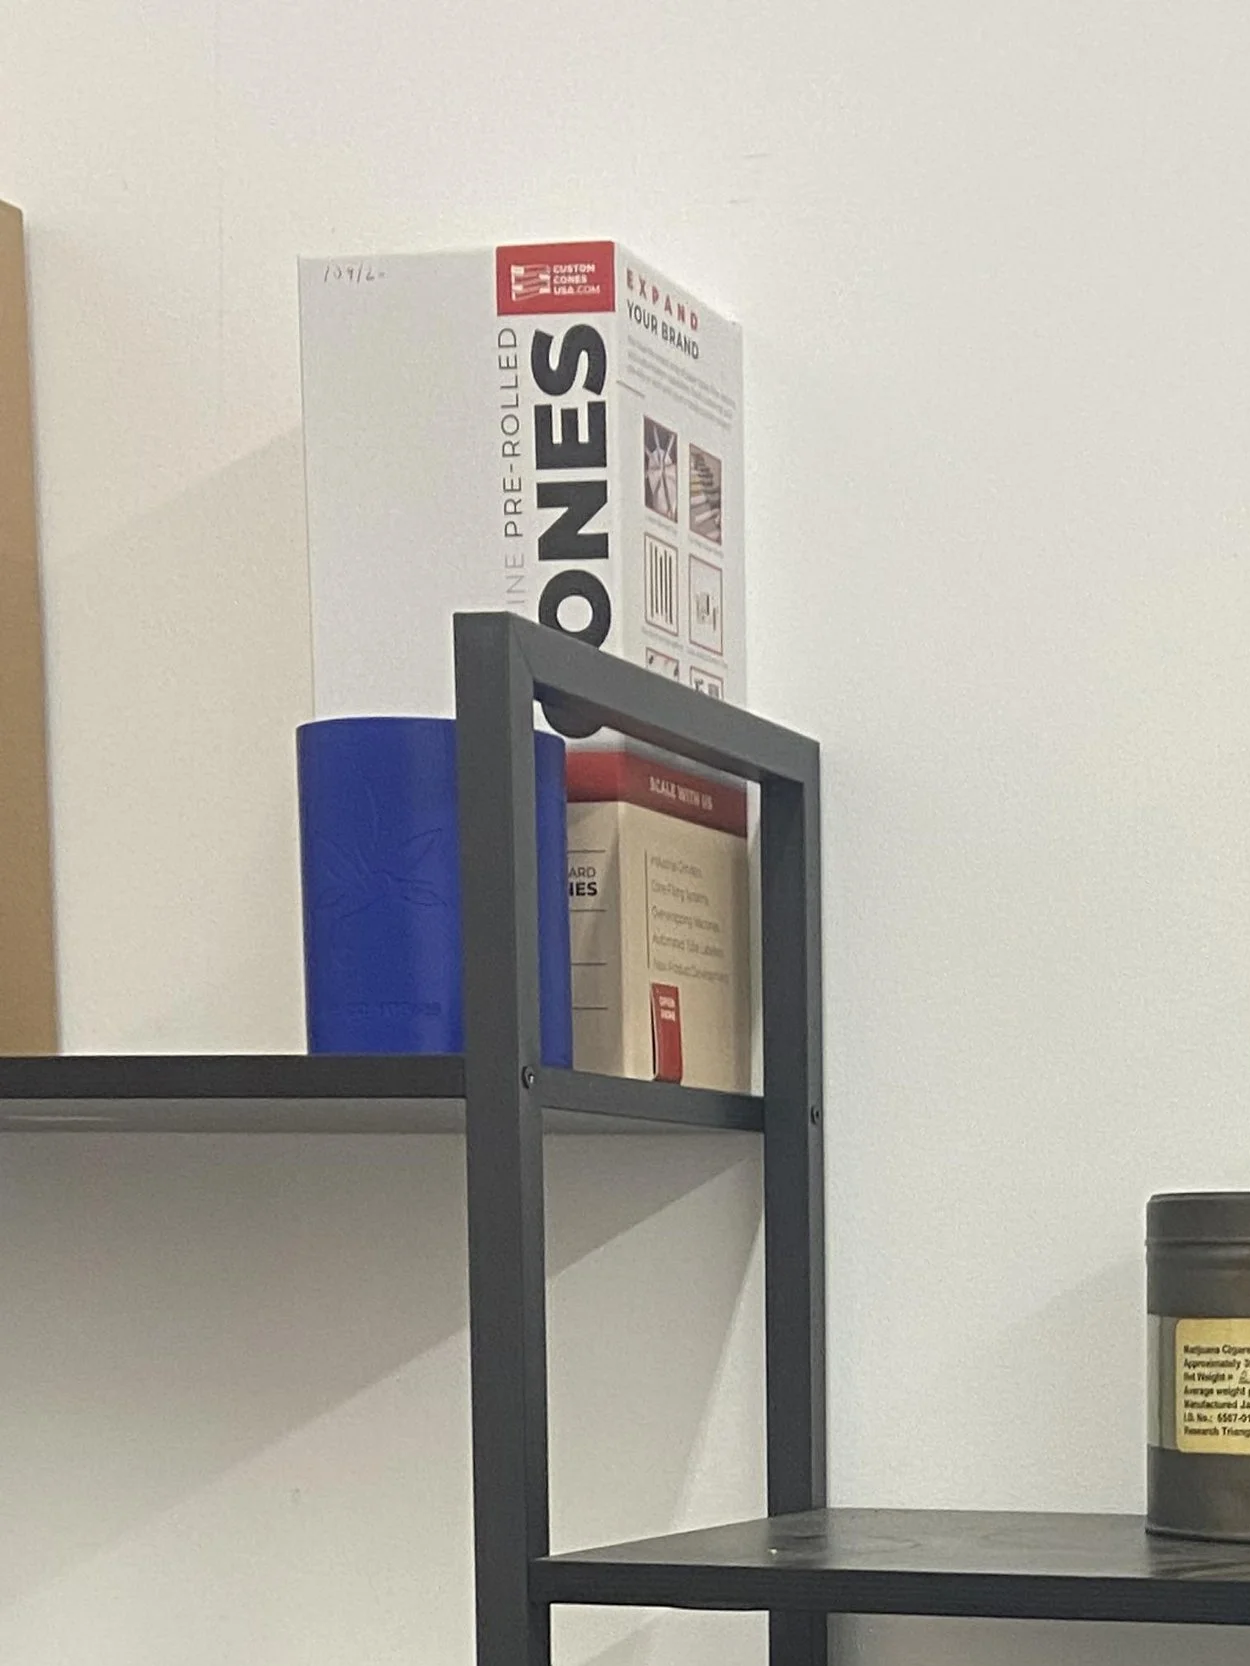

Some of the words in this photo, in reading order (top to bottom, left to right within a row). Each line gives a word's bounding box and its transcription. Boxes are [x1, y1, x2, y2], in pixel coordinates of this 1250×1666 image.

[553, 263, 596, 274] CUSTOM
[553, 275, 587, 284] CONES
[553, 285, 600, 296] USA.COM
[626, 267, 699, 332] EXPAND
[627, 299, 658, 337] YOUR
[661, 320, 700, 360] BRAND
[498, 327, 523, 538] PRE-ROLLED
[568, 866, 597, 878] ARD
[1217, 1386, 1246, 1397] weight
